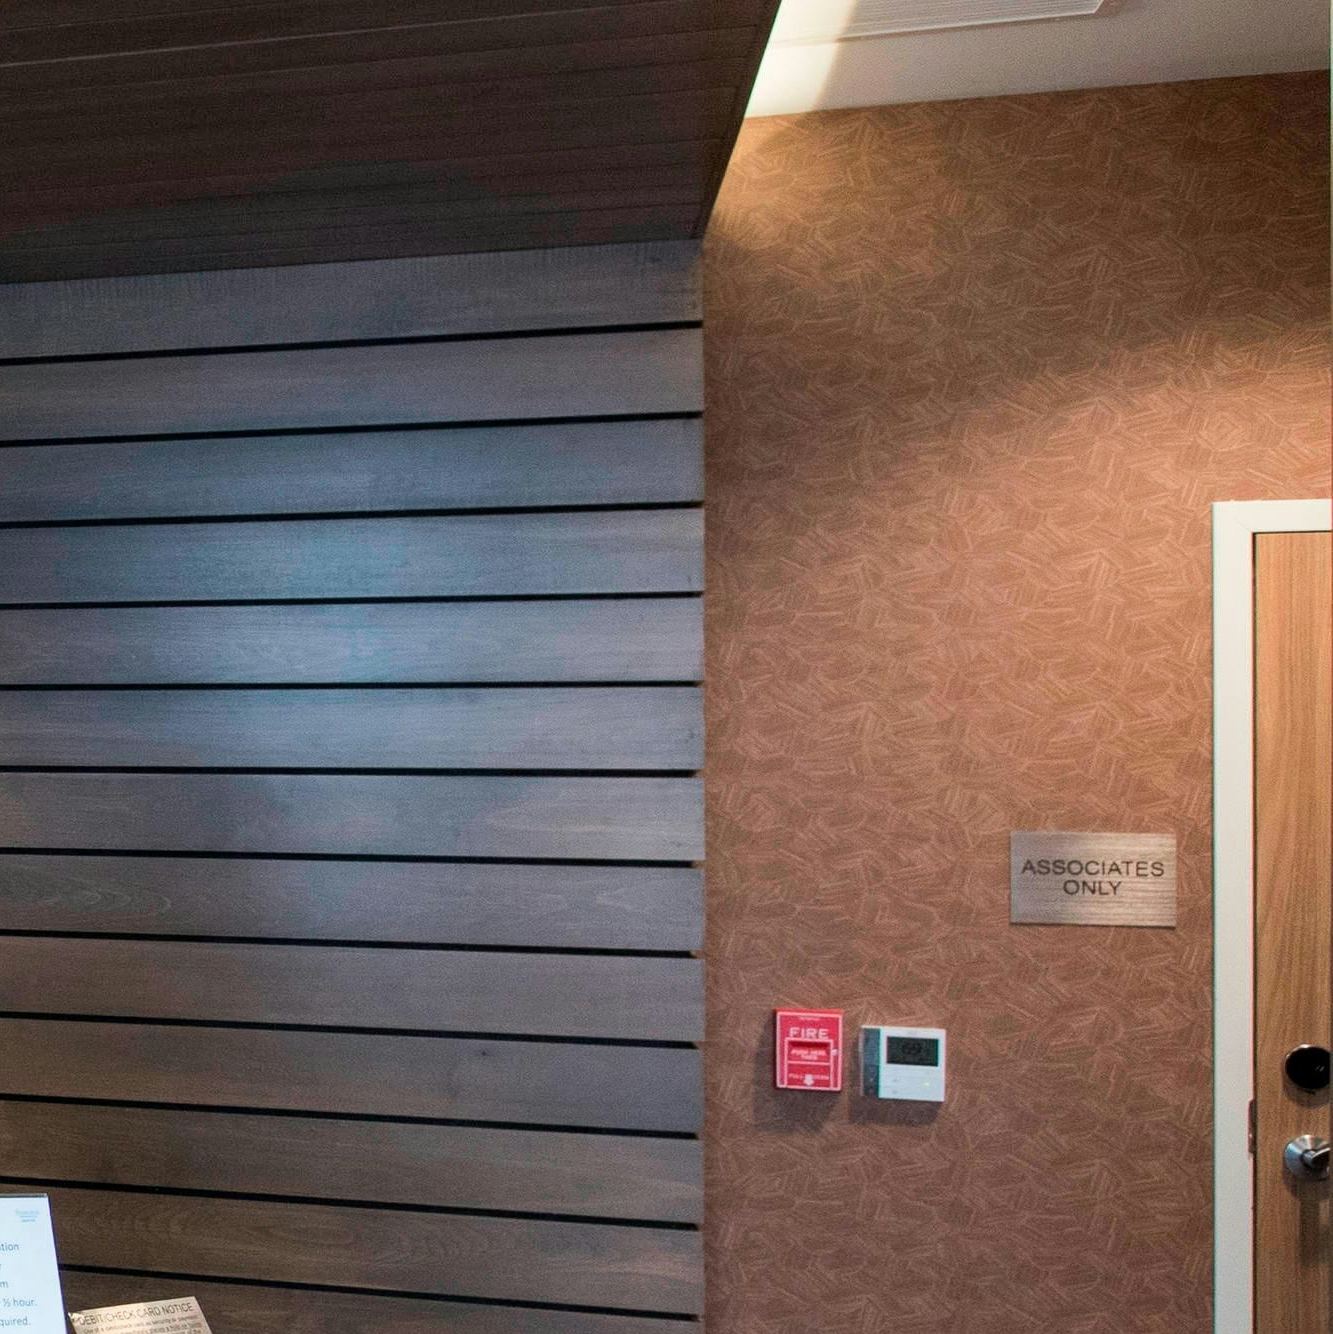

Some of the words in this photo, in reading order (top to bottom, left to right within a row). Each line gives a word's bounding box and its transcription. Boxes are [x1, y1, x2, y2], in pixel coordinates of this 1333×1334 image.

[1021, 859, 1165, 877] ASSOCIATES
[1063, 879, 1122, 896] ONLY
[789, 1026, 829, 1040] FIRE
[12, 1298, 38, 1307] hour.
[136, 1307, 161, 1318] CARD
[162, 1302, 194, 1315] NOTICE
